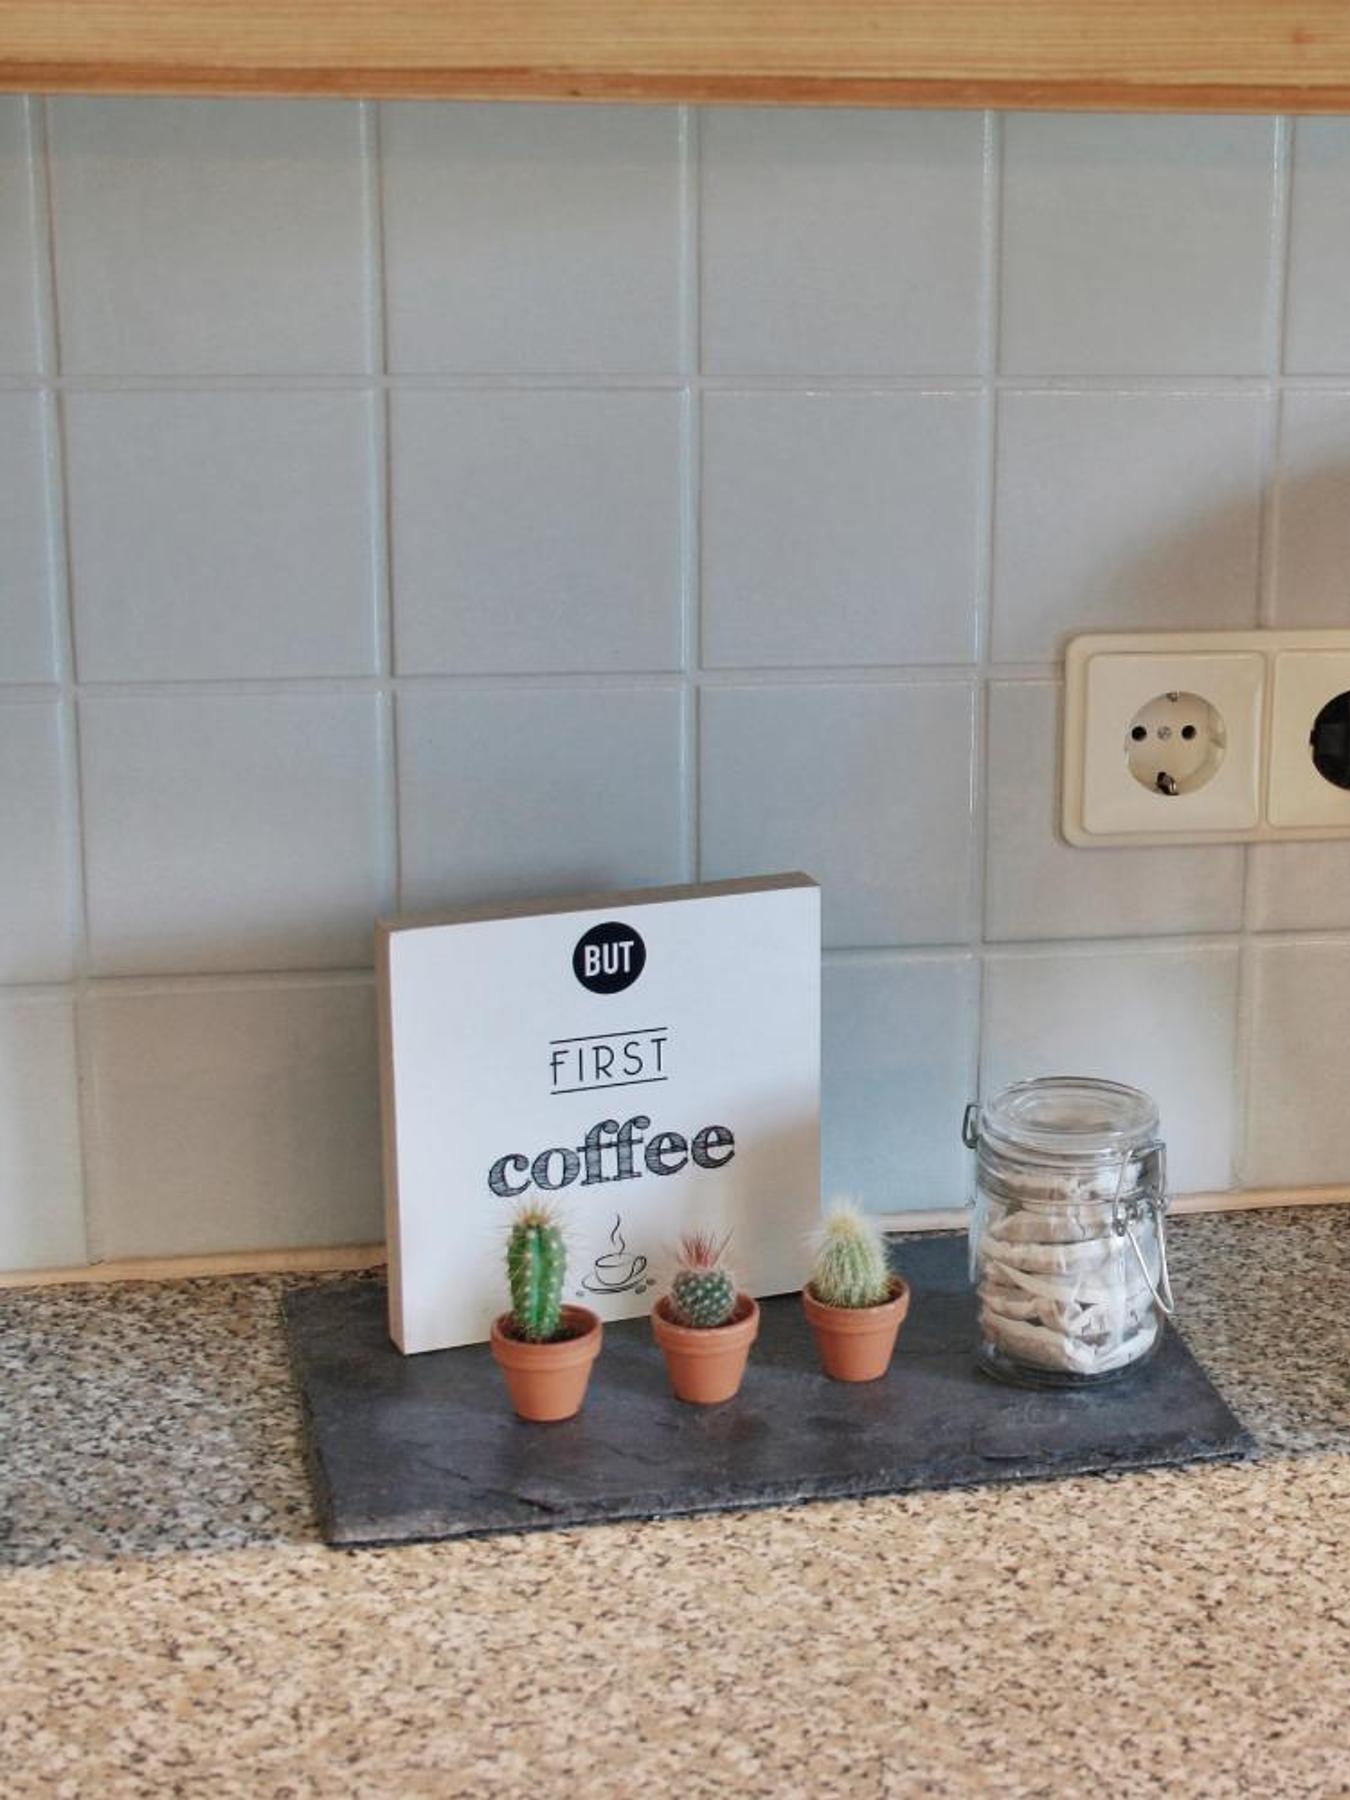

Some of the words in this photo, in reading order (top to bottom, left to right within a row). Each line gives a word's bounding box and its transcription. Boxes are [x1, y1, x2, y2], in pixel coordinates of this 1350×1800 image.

[584, 941, 635, 977] BUT
[549, 1037, 669, 1086] FIRST
[487, 1115, 736, 1198] coffee
